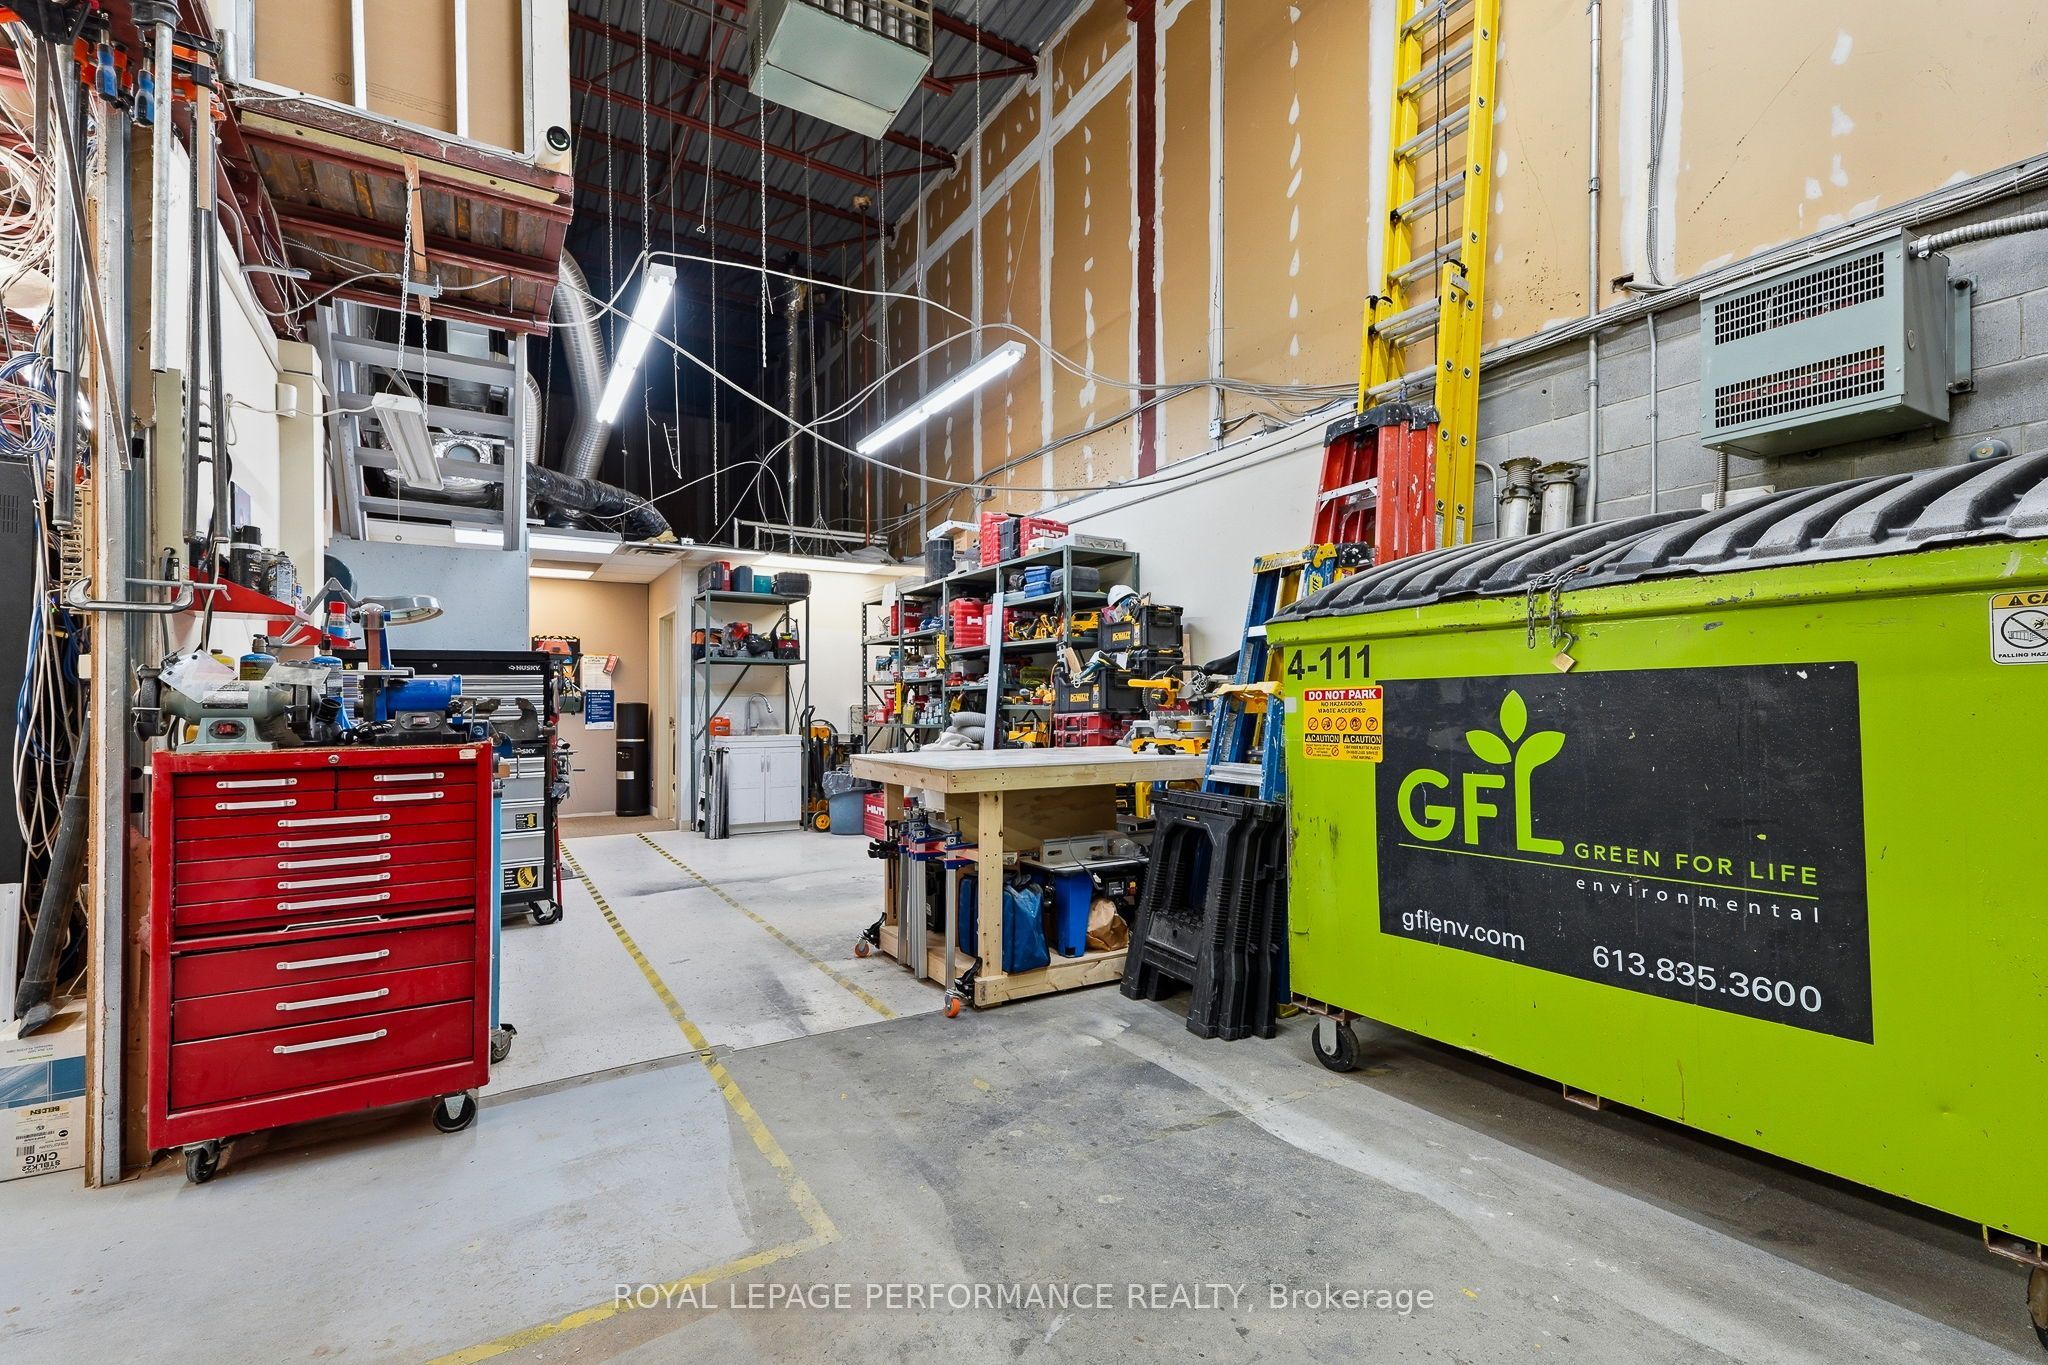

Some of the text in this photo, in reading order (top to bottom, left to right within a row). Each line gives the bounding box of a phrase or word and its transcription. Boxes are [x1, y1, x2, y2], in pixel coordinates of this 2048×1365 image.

[1288, 644, 1370, 680] 4-111
[1308, 689, 1377, 700] DO NOT PARK
[1311, 734, 1339, 743] CAUTION
[1350, 735, 1381, 744] CAUTION
[1398, 690, 1565, 855] GFL
[1575, 843, 1818, 885] GREEN FOR LIFE
[1576, 876, 1819, 924] environmental
[1402, 910, 1525, 951] gflenv.com
[1592, 945, 1822, 1013] 613.835.3600
[25, 1151, 58, 1165] CMG
